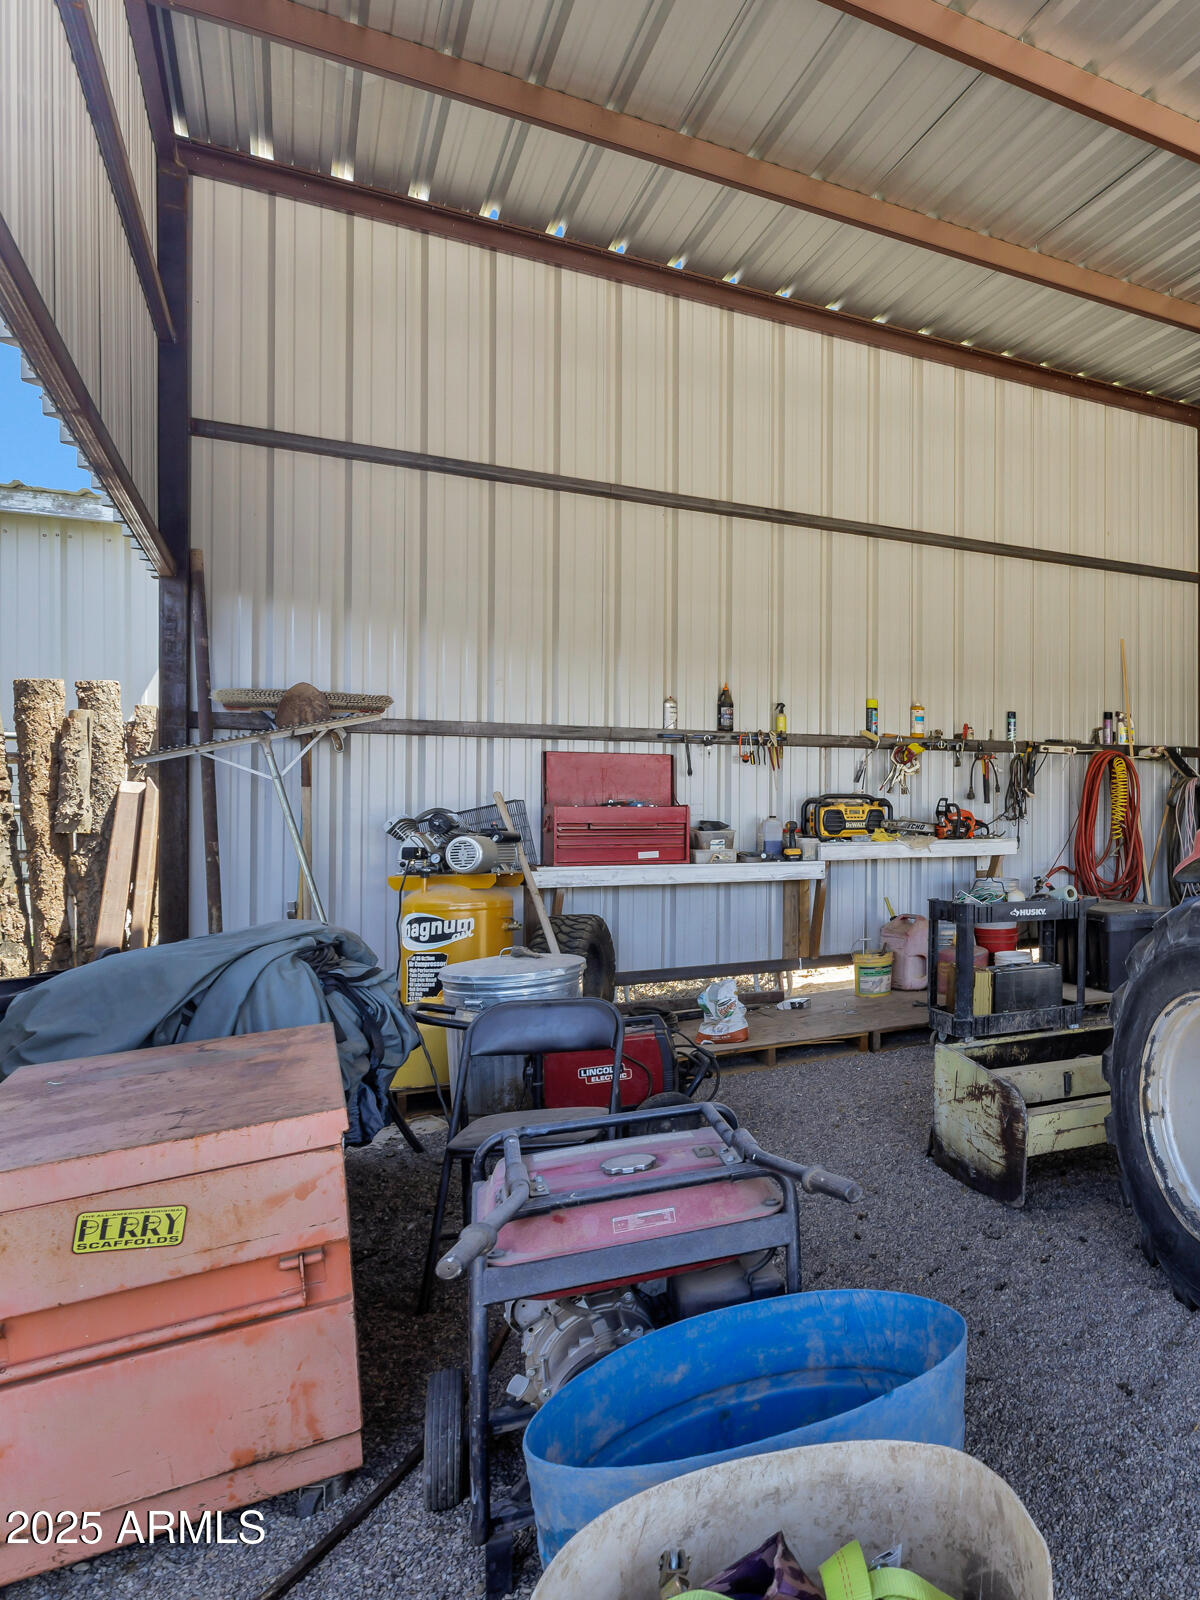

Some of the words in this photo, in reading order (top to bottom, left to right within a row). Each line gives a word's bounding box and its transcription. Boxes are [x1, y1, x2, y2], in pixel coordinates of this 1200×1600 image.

[581, 1066, 622, 1077] LINCOL
[591, 1073, 627, 1082] ELECTIC
[78, 1213, 183, 1242] PERRY
[77, 1235, 179, 1250] SCAFFOLDS
